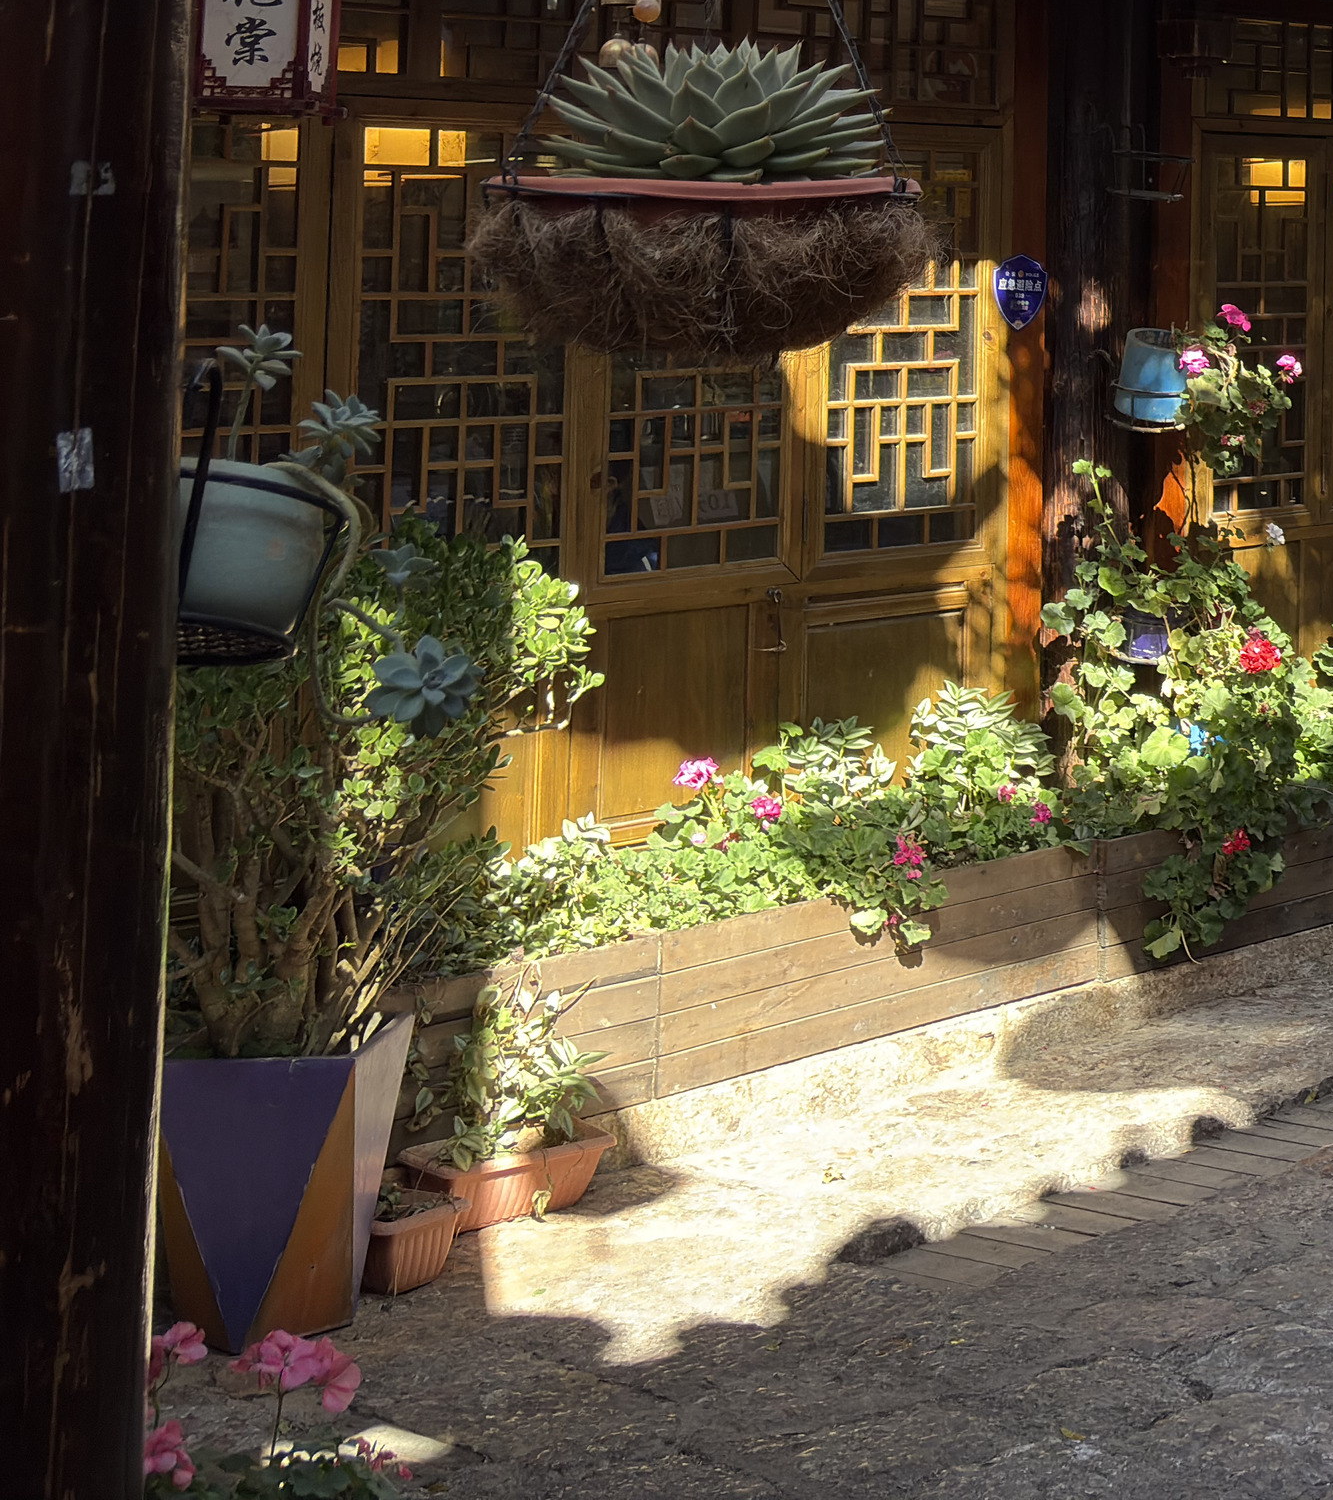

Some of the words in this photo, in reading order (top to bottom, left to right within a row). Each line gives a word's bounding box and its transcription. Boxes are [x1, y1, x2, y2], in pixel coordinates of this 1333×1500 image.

[998, 277, 1042, 292] 应急避险点
